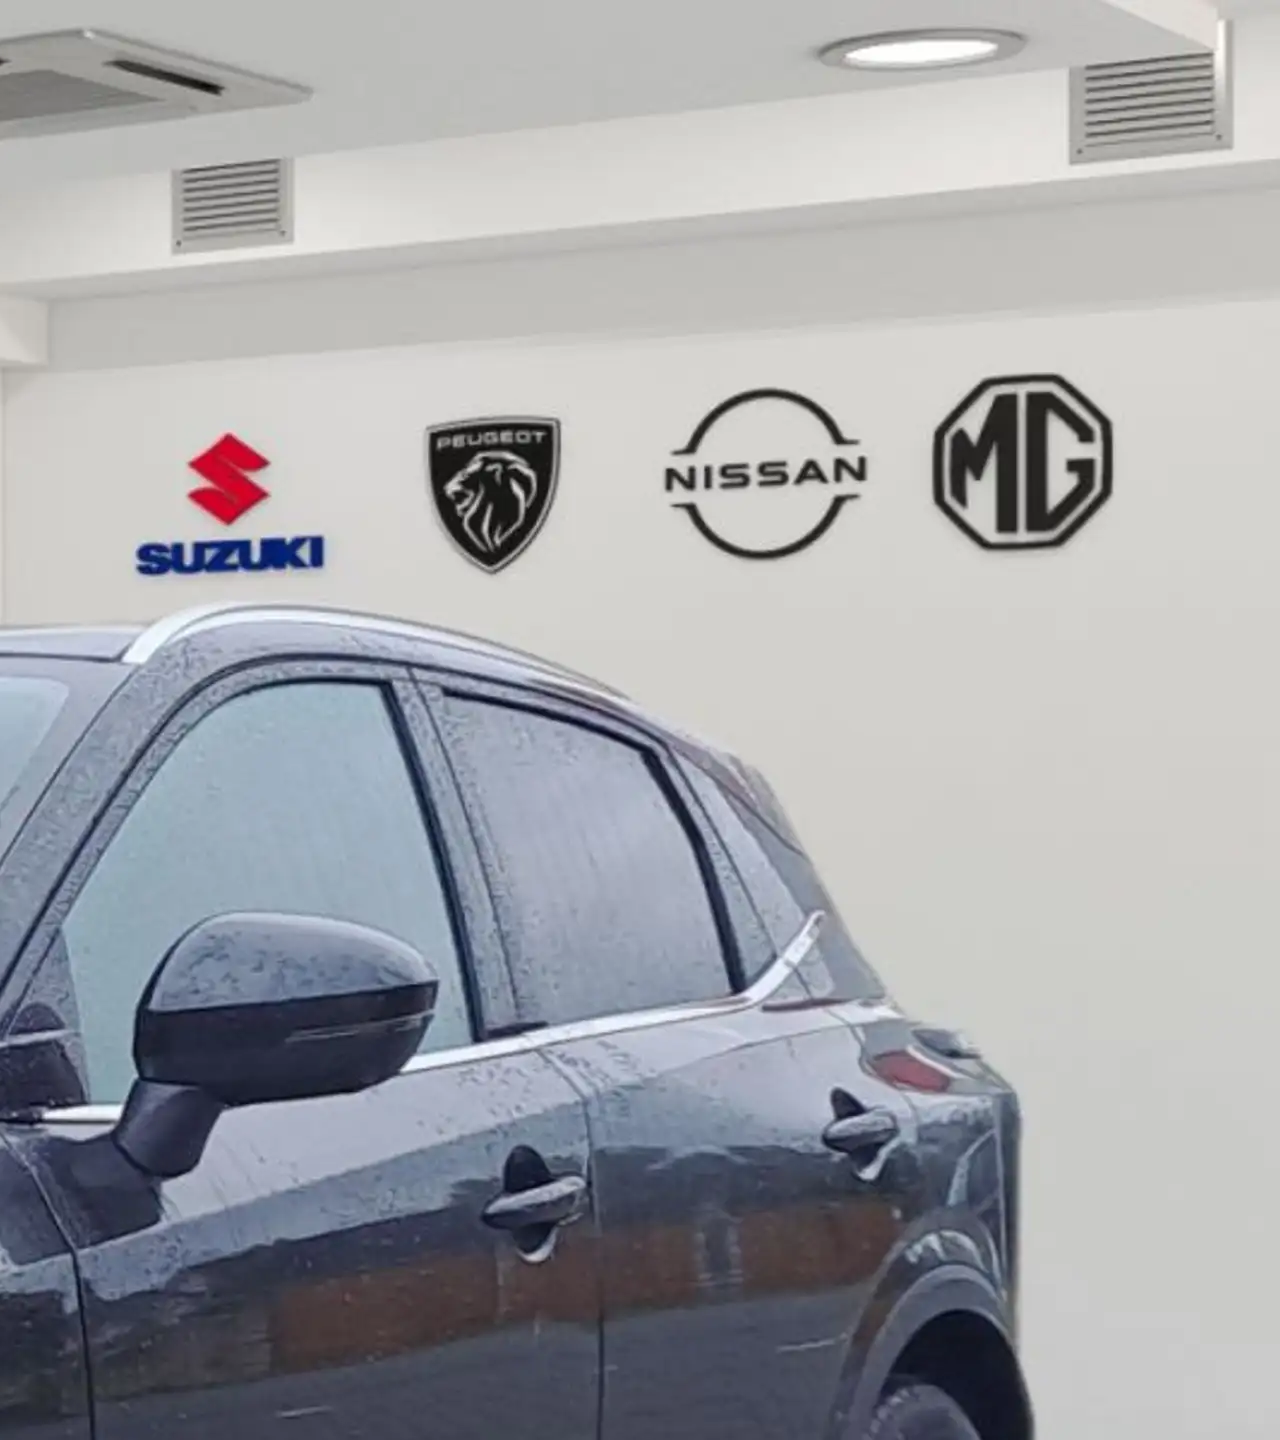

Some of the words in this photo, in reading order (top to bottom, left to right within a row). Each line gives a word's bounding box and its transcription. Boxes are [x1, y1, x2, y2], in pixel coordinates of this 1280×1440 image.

[436, 428, 547, 450] PEUGEOT
[664, 456, 868, 494] NISSAN
[949, 392, 1097, 536] MG
[135, 536, 325, 576] SUZUKI
